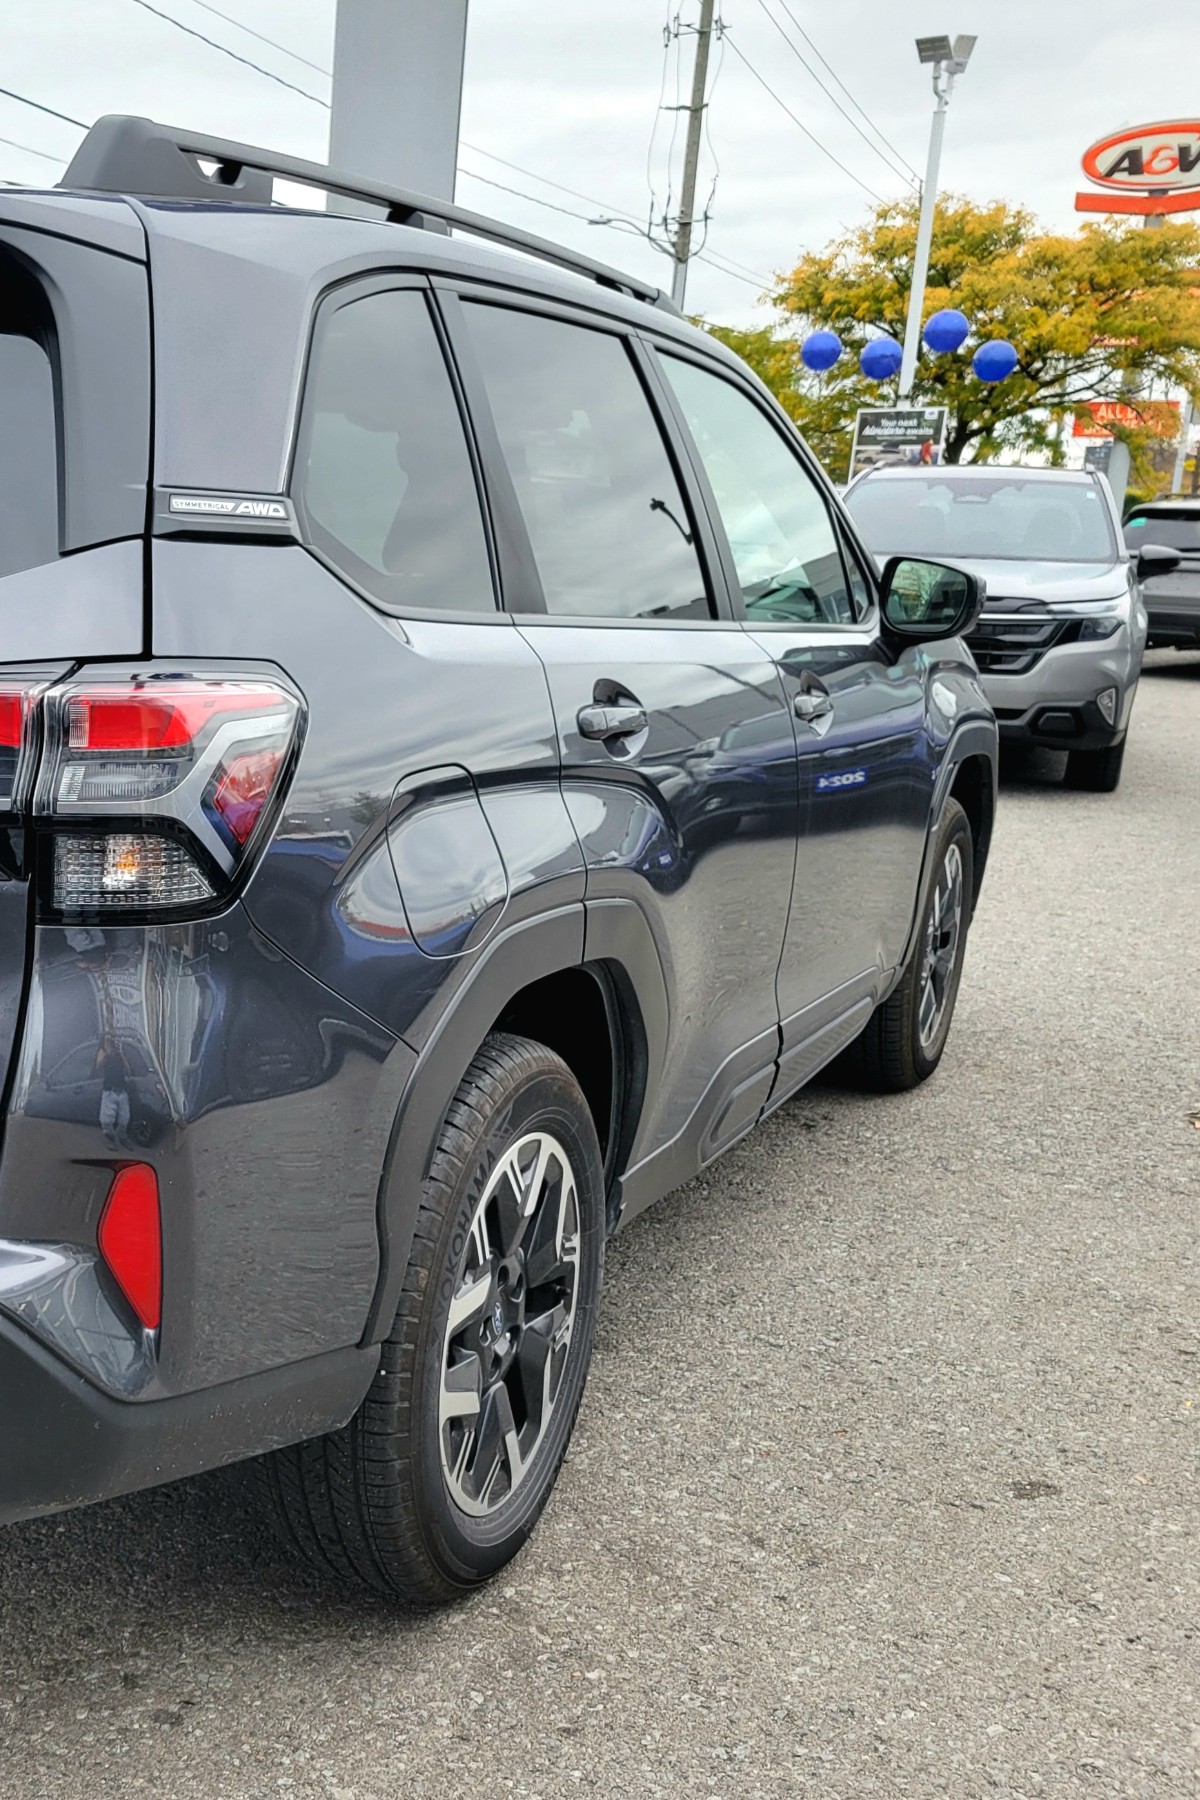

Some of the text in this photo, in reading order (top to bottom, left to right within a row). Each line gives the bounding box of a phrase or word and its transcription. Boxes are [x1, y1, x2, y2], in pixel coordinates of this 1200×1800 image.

[173, 499, 286, 517] SYMMETRICAL AWD
[432, 1147, 496, 1319] YOKOHAMA
